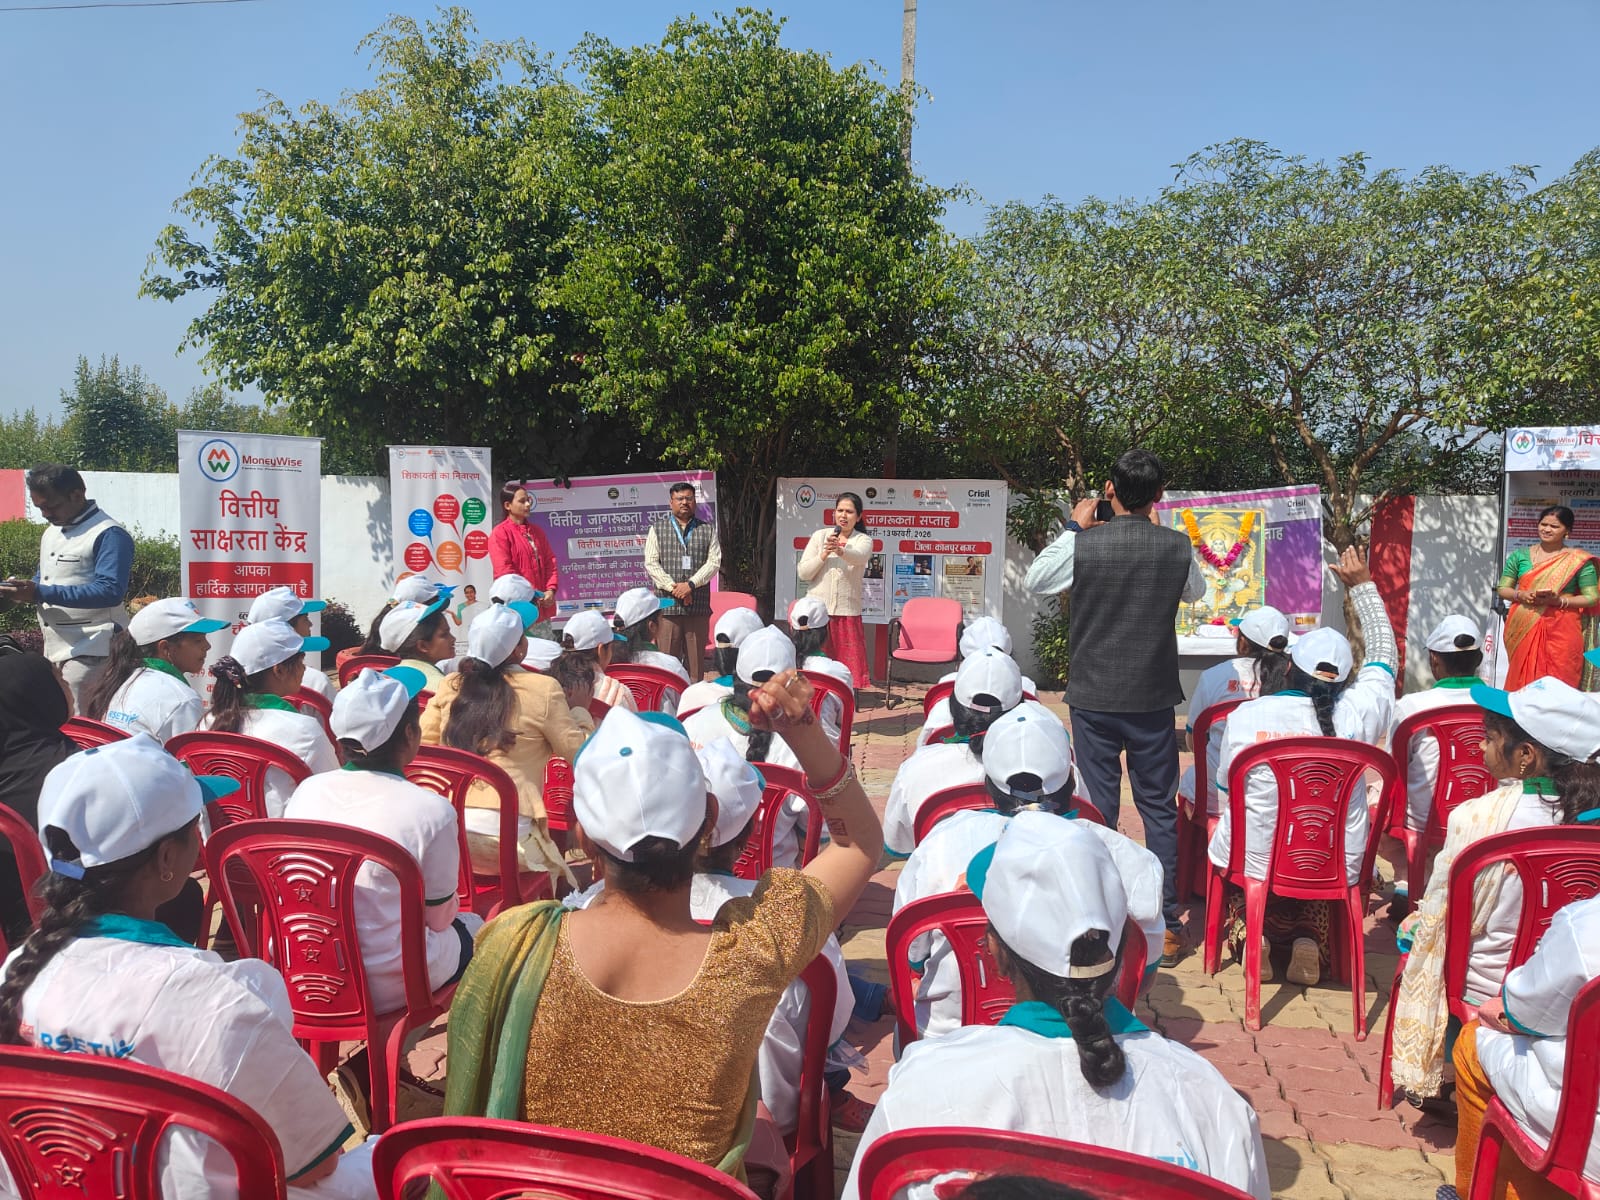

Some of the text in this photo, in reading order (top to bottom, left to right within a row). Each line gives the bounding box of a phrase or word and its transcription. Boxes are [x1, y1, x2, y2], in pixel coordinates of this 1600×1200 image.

[242, 454, 303, 467] MoneyWise
[401, 469, 481, 480] शिकायतों का निवारण
[968, 489, 990, 498] Crisil
[219, 489, 280, 519] वित्तीय
[548, 511, 582, 528] वित्तीय
[586, 511, 642, 526] जागरूकता
[866, 514, 951, 528] जागरूकता सप्ताह
[190, 522, 308, 553] साक्षरता केंद्र
[914, 530, 932, 538] 2026
[577, 538, 601, 550] वित्तीय
[604, 538, 634, 549] साक्षरता
[914, 540, 977, 554] जिला कानपुर नगर
[233, 565, 271, 577] आपका
[608, 560, 618, 569] की
[195, 579, 231, 595] हार्दिक
[233, 583, 266, 595] स्वागत
[300, 579, 308, 595] है
[40, 1033, 110, 1057] RSETI
